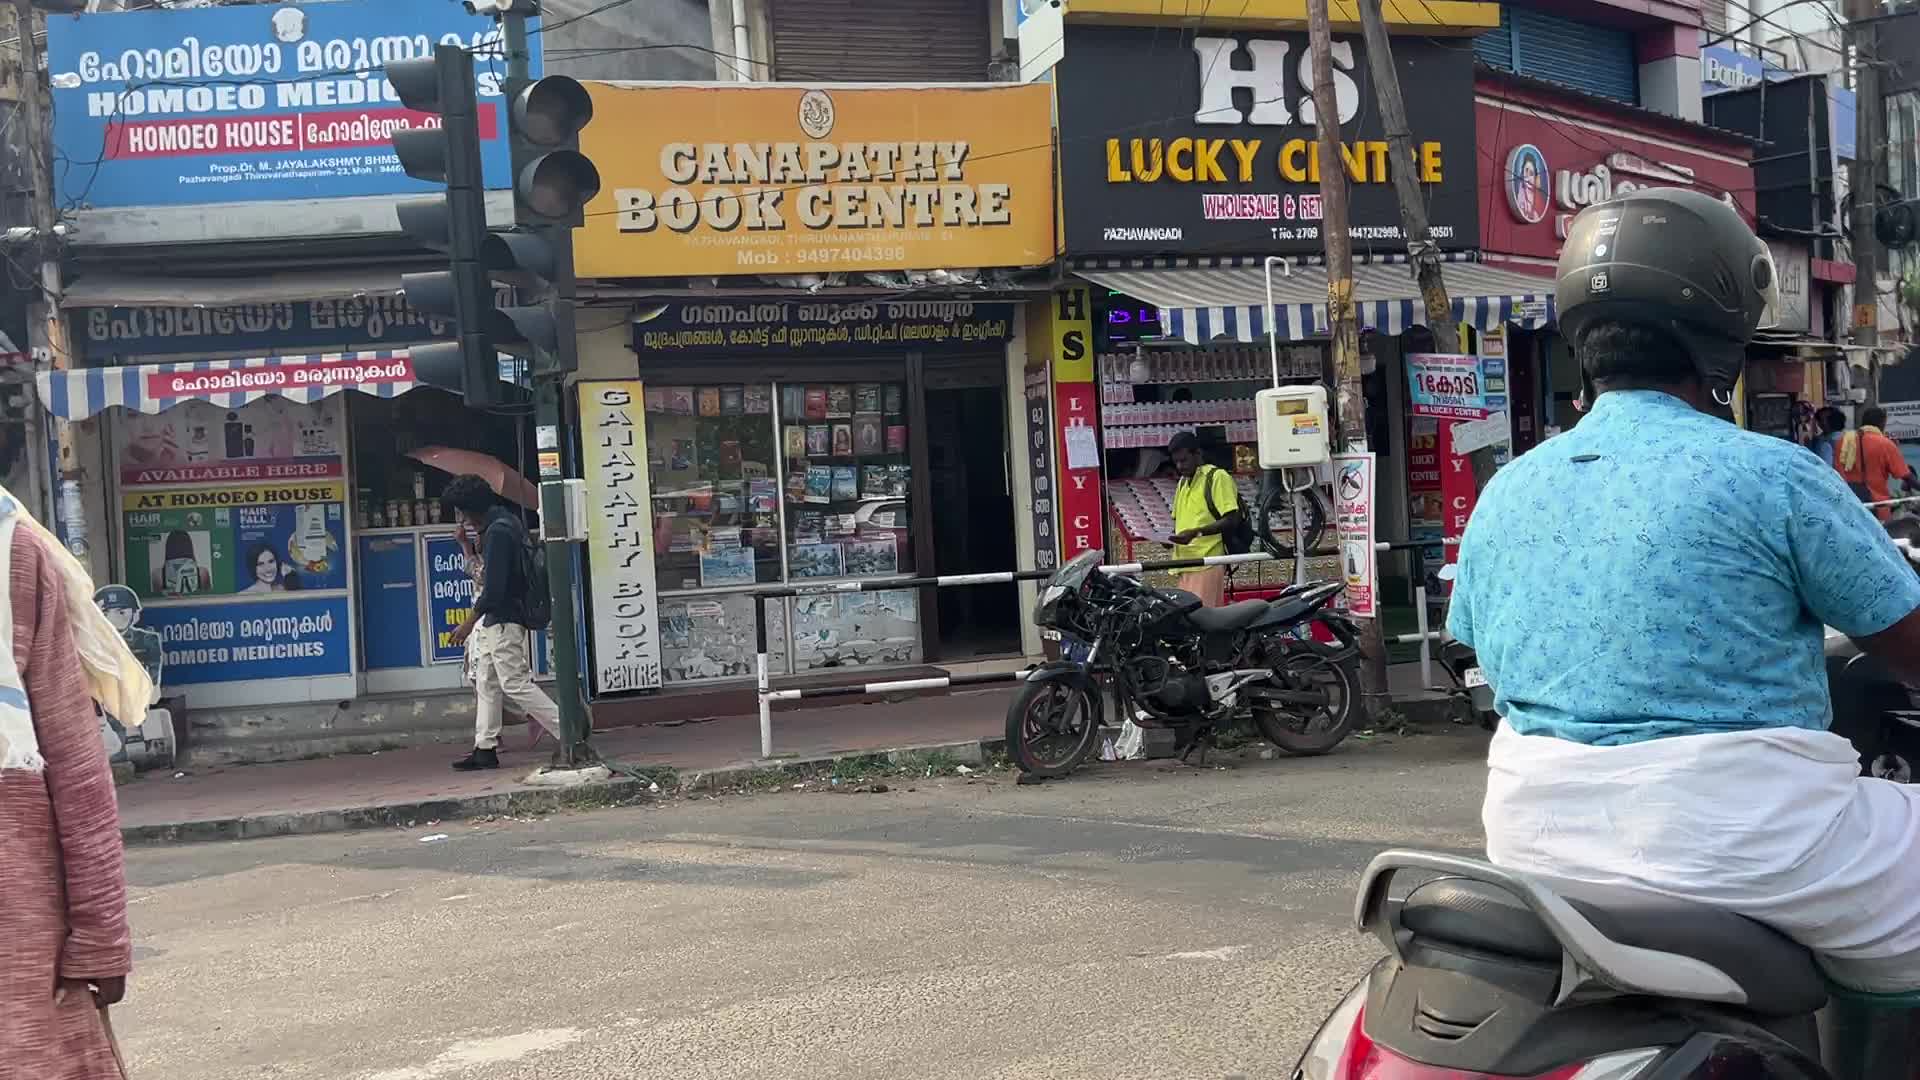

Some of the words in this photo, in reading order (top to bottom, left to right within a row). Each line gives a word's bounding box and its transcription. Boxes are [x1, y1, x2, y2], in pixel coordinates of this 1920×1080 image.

[79, 36, 282, 82] ഹോമിയോ
[1194, 37, 1360, 126] HS
[87, 84, 265, 117] HOMOEO
[276, 70, 505, 108] MEDICS
[129, 123, 219, 152] HOMOEO
[225, 119, 293, 148] HOUSE
[275, 156, 362, 171] JAYALAKSHMY
[365, 154, 400, 166] BHMS
[660, 142, 969, 184] GANAPATHY
[1106, 137, 1261, 184] LUCKY
[1278, 138, 1442, 183] CNTE
[614, 188, 785, 233] BOOK
[797, 183, 1011, 229] CENTRE
[1202, 194, 1279, 219] WHOLESALE
[1284, 194, 1295, 219] &
[1300, 194, 1324, 219] RET
[1104, 228, 1182, 240] PAZHAVANGADI
[737, 250, 777, 265] Mob
[798, 303, 880, 324] ബുക്ക
[172, 371, 285, 391] ഹോമിയോ
[1454, 407, 1481, 417] CENTRE
[137, 467, 260, 482] AVAILABLE
[267, 463, 328, 477] HERE
[137, 494, 164, 509] AT
[171, 490, 258, 506] HOMOEO
[264, 487, 333, 503] HOUSE
[240, 508, 267, 517] HAIR
[240, 609, 332, 641] മരുന്നുകൾ
[232, 642, 325, 661] MEDICINES
[603, 662, 658, 690] CENTRE
